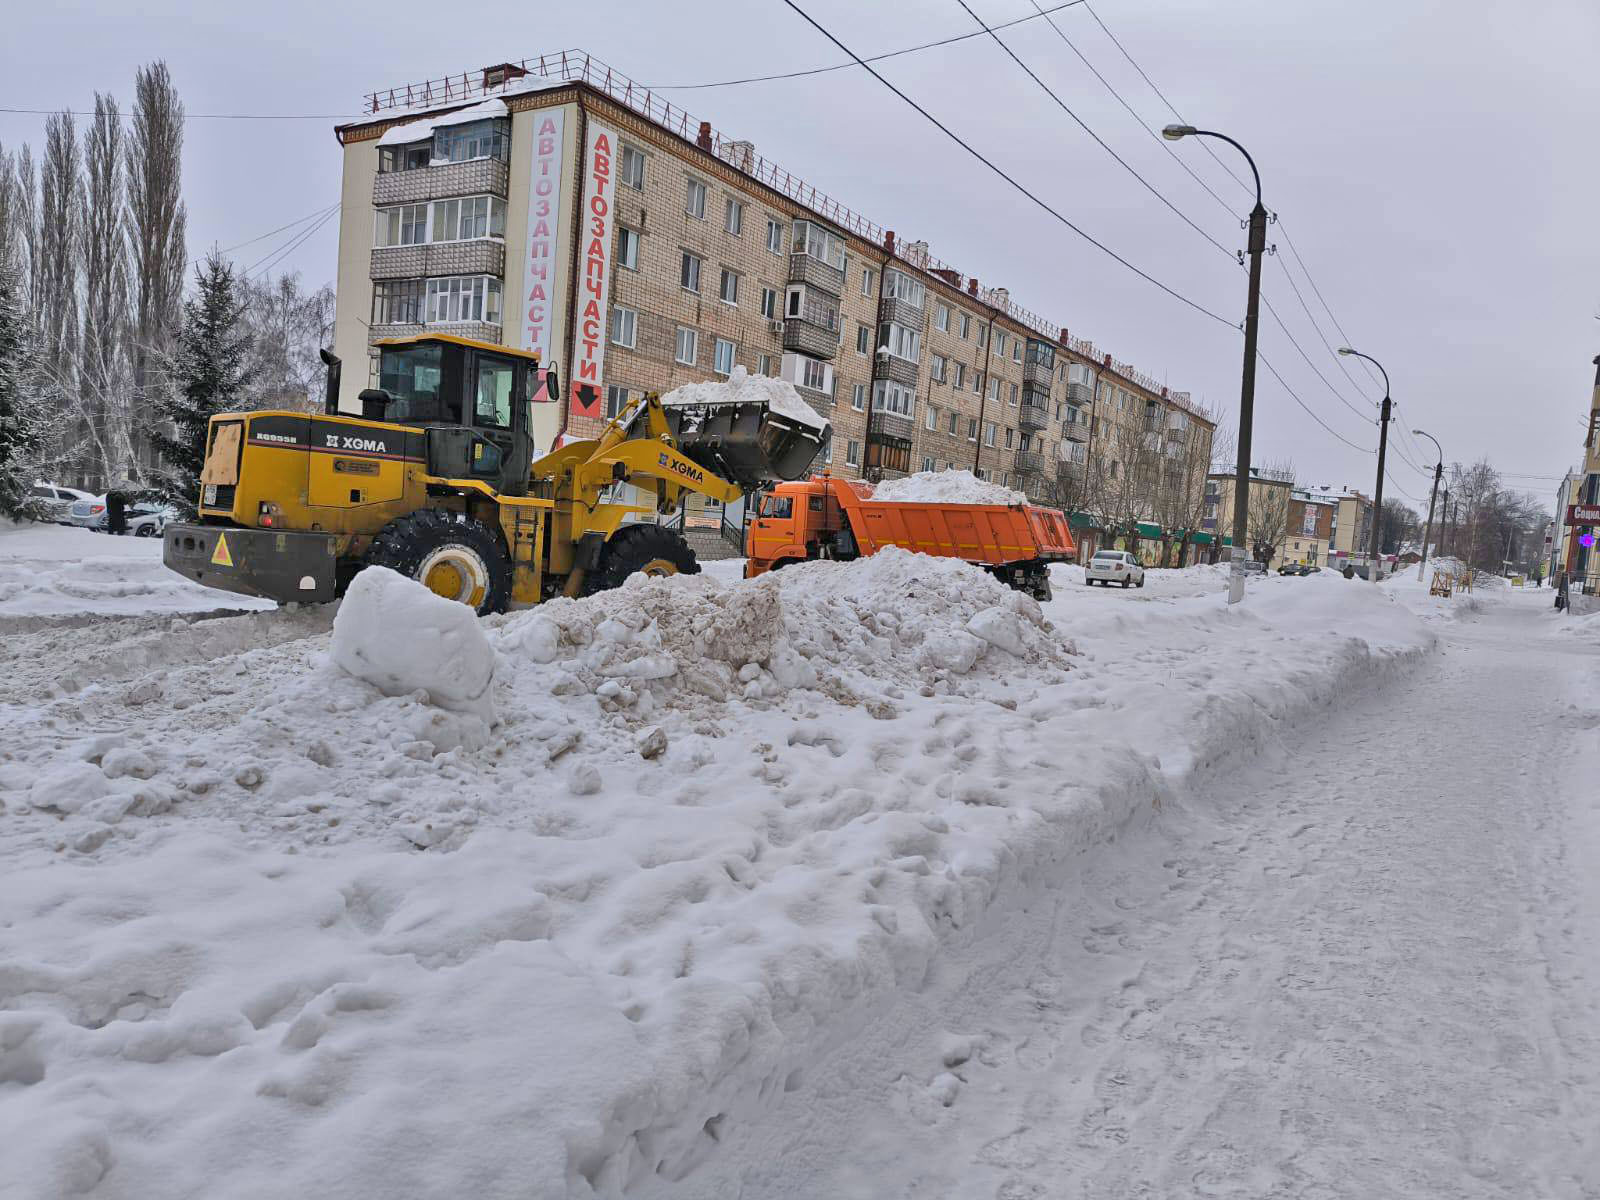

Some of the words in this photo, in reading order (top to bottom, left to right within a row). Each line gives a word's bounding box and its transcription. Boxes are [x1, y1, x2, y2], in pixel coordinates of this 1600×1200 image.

[580, 133, 611, 381] АВТОЗАПЧАСТИ
[342, 437, 386, 453] XGMA
[671, 459, 703, 483] XGMA
